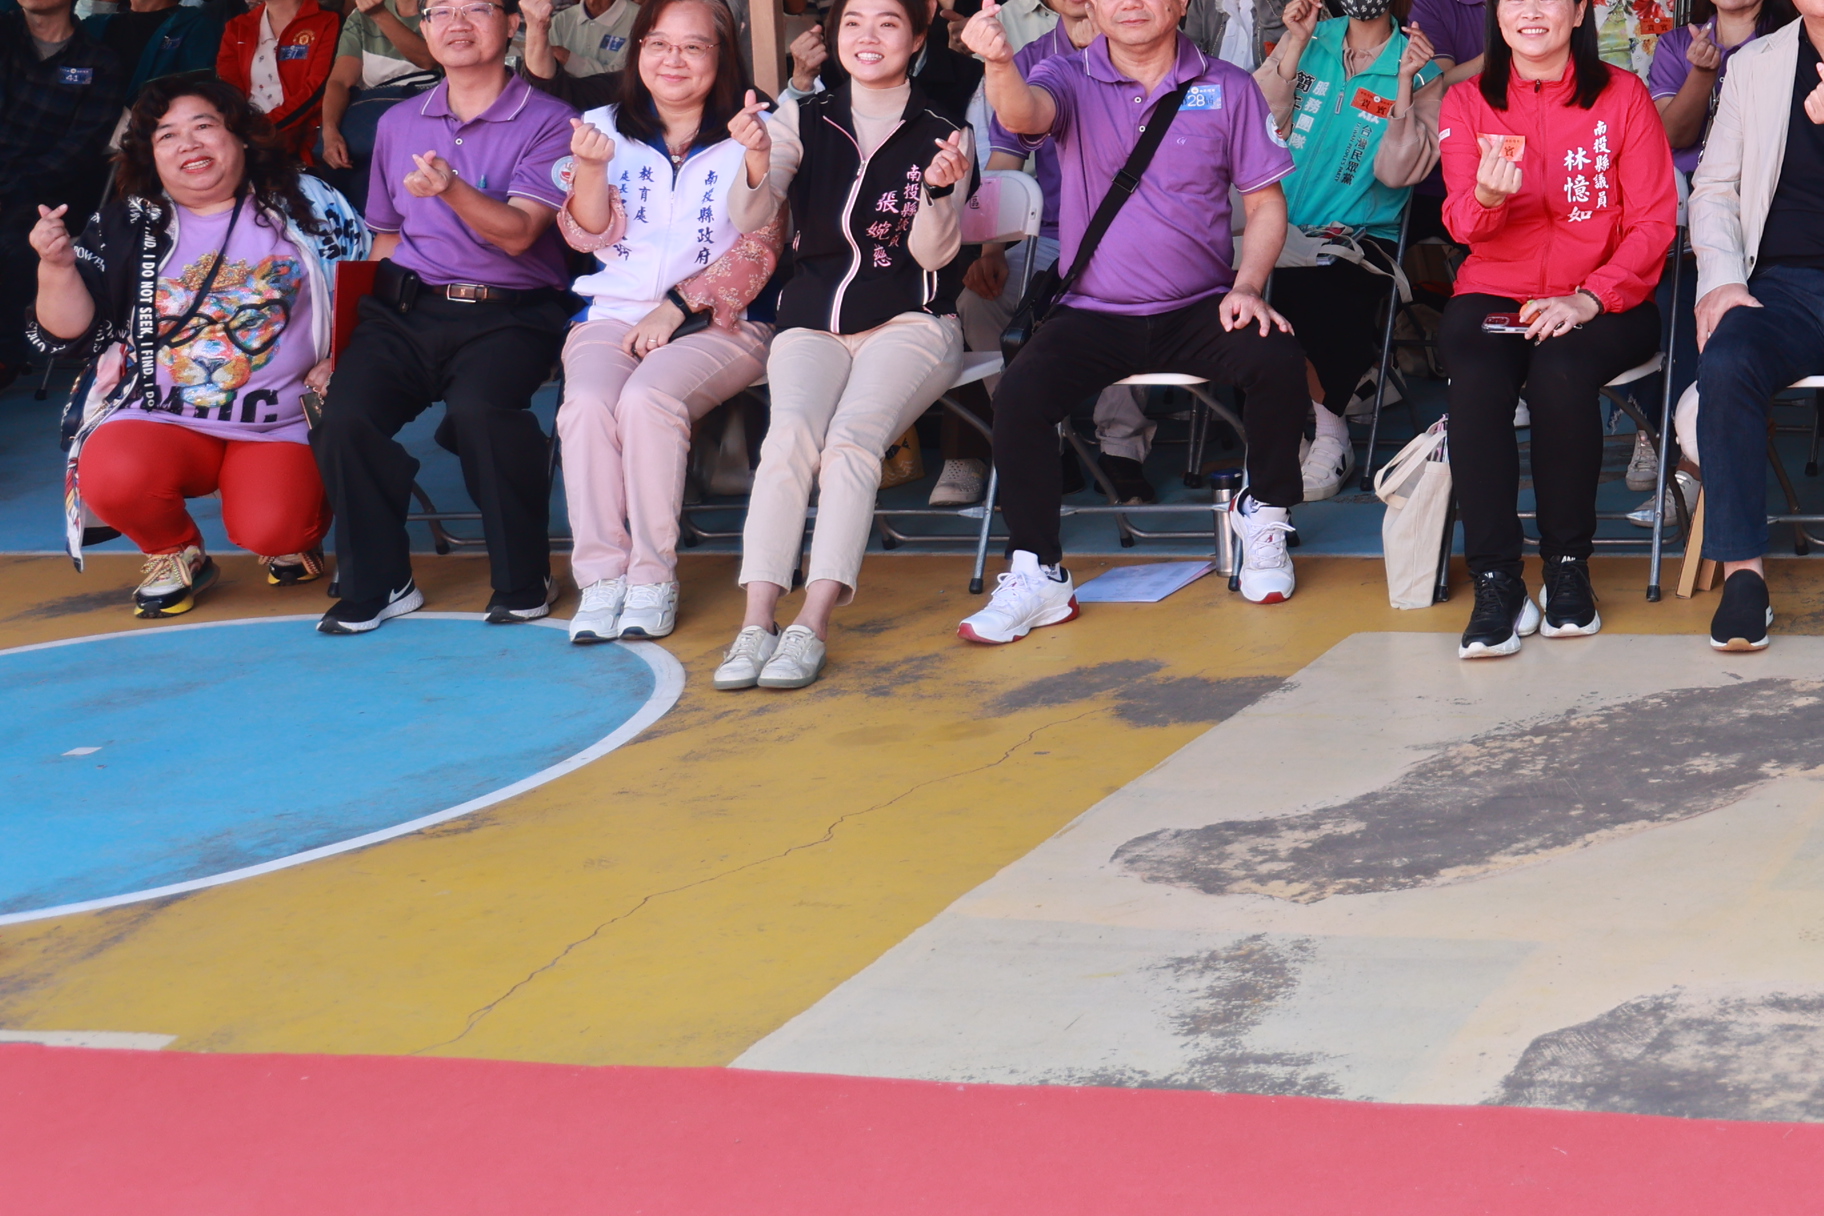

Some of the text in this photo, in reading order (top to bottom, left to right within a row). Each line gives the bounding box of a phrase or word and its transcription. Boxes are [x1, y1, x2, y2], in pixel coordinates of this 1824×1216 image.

[1289, 81, 1330, 149] 服務團隊
[1563, 147, 1593, 222] 林憶如
[1592, 120, 1611, 209] 南投縣議員
[634, 165, 655, 224] 教育處
[694, 170, 718, 265] 南投縣政府
[140, 281, 154, 303] NOT
[141, 261, 156, 277] DO
[137, 306, 153, 339] SEEK,
[141, 349, 154, 379] FIND.
[145, 391, 155, 407] DO
